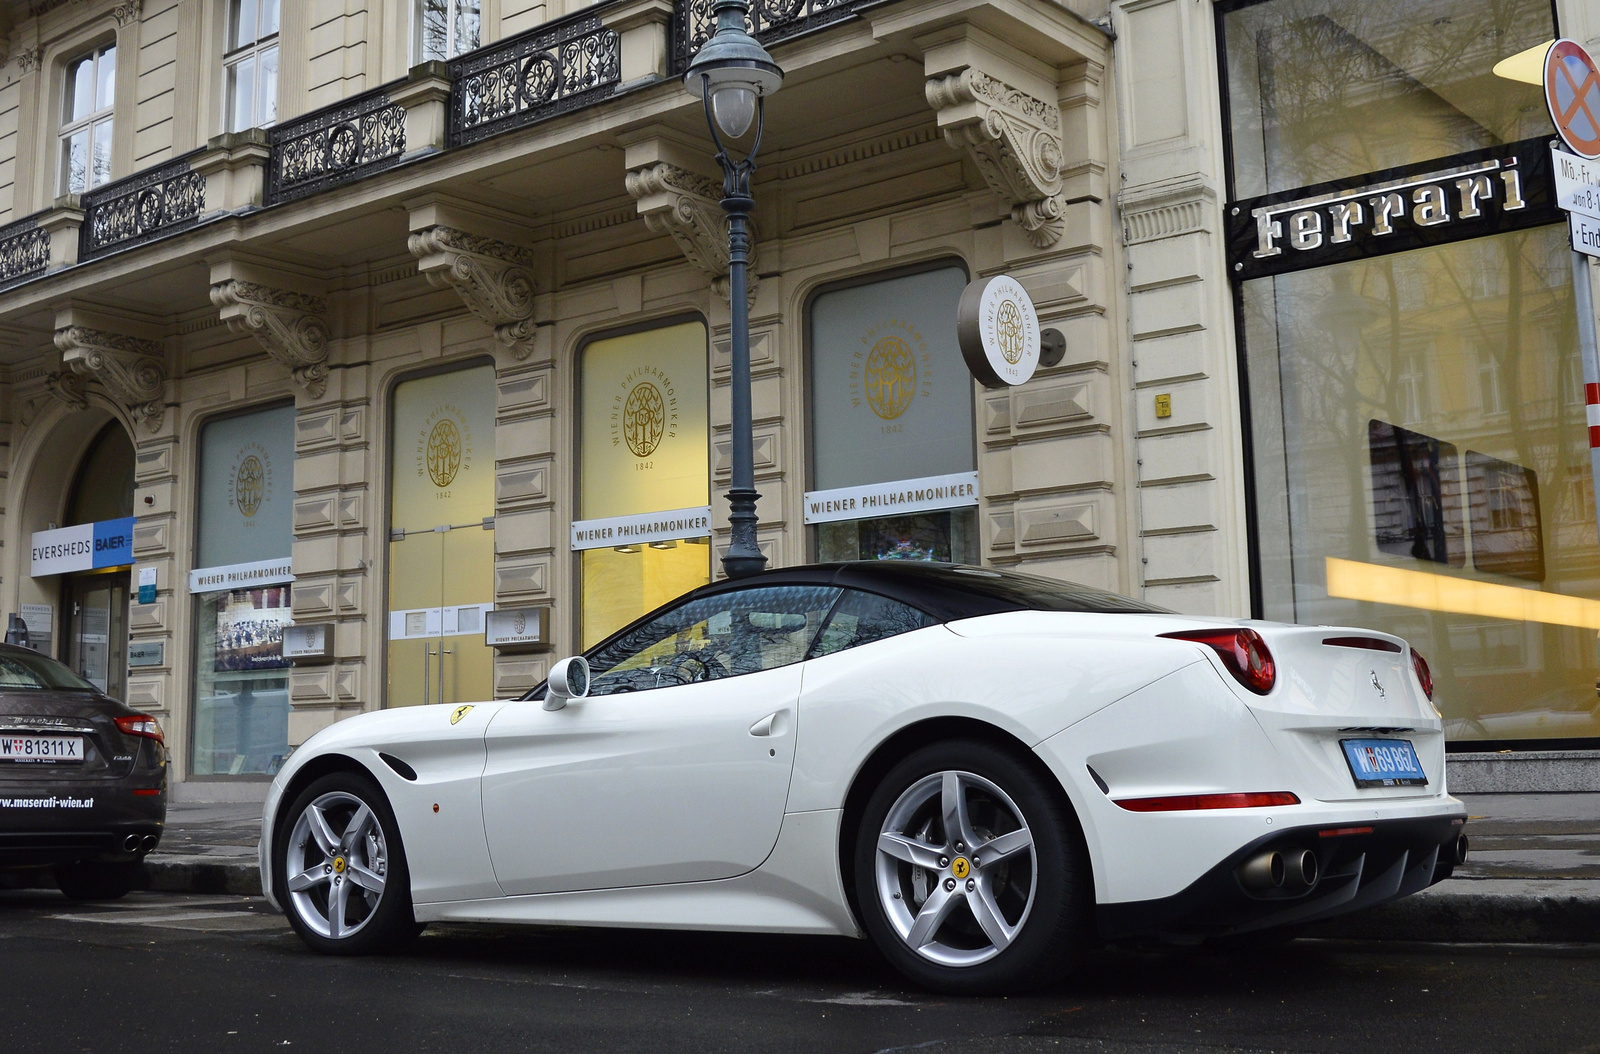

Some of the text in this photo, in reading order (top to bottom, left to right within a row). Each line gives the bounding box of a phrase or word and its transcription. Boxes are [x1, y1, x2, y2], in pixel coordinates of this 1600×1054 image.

[1251, 156, 1526, 259] Ferrari
[993, 285, 1033, 357] PHILHARMONIKER
[849, 318, 932, 408] WIENER PHILHARMONIKER
[1005, 367, 1018, 377] 1842
[611, 365, 678, 447] WIENER PHILHARMONIKER
[416, 404, 473, 477] WIENER PHILHARMONIKER
[880, 424, 903, 434] 1842
[635, 461, 654, 471] 1842
[436, 491, 451, 499] 1842
[810, 483, 974, 514] WIENER PHILHARMONIKER
[576, 516, 707, 541] WIENER PHILHARMONIKER
[32, 540, 91, 561] EVERSHEDS
[95, 535, 125, 552] BAIER
[198, 566, 291, 585] WIENER PHILHARMONIKER
[10, 717, 68, 726] Maserati
[2, 739, 76, 756] W 81311 X
[1354, 747, 1371, 773] W
[0, 796, 94, 808] w.maserati-wien.at
